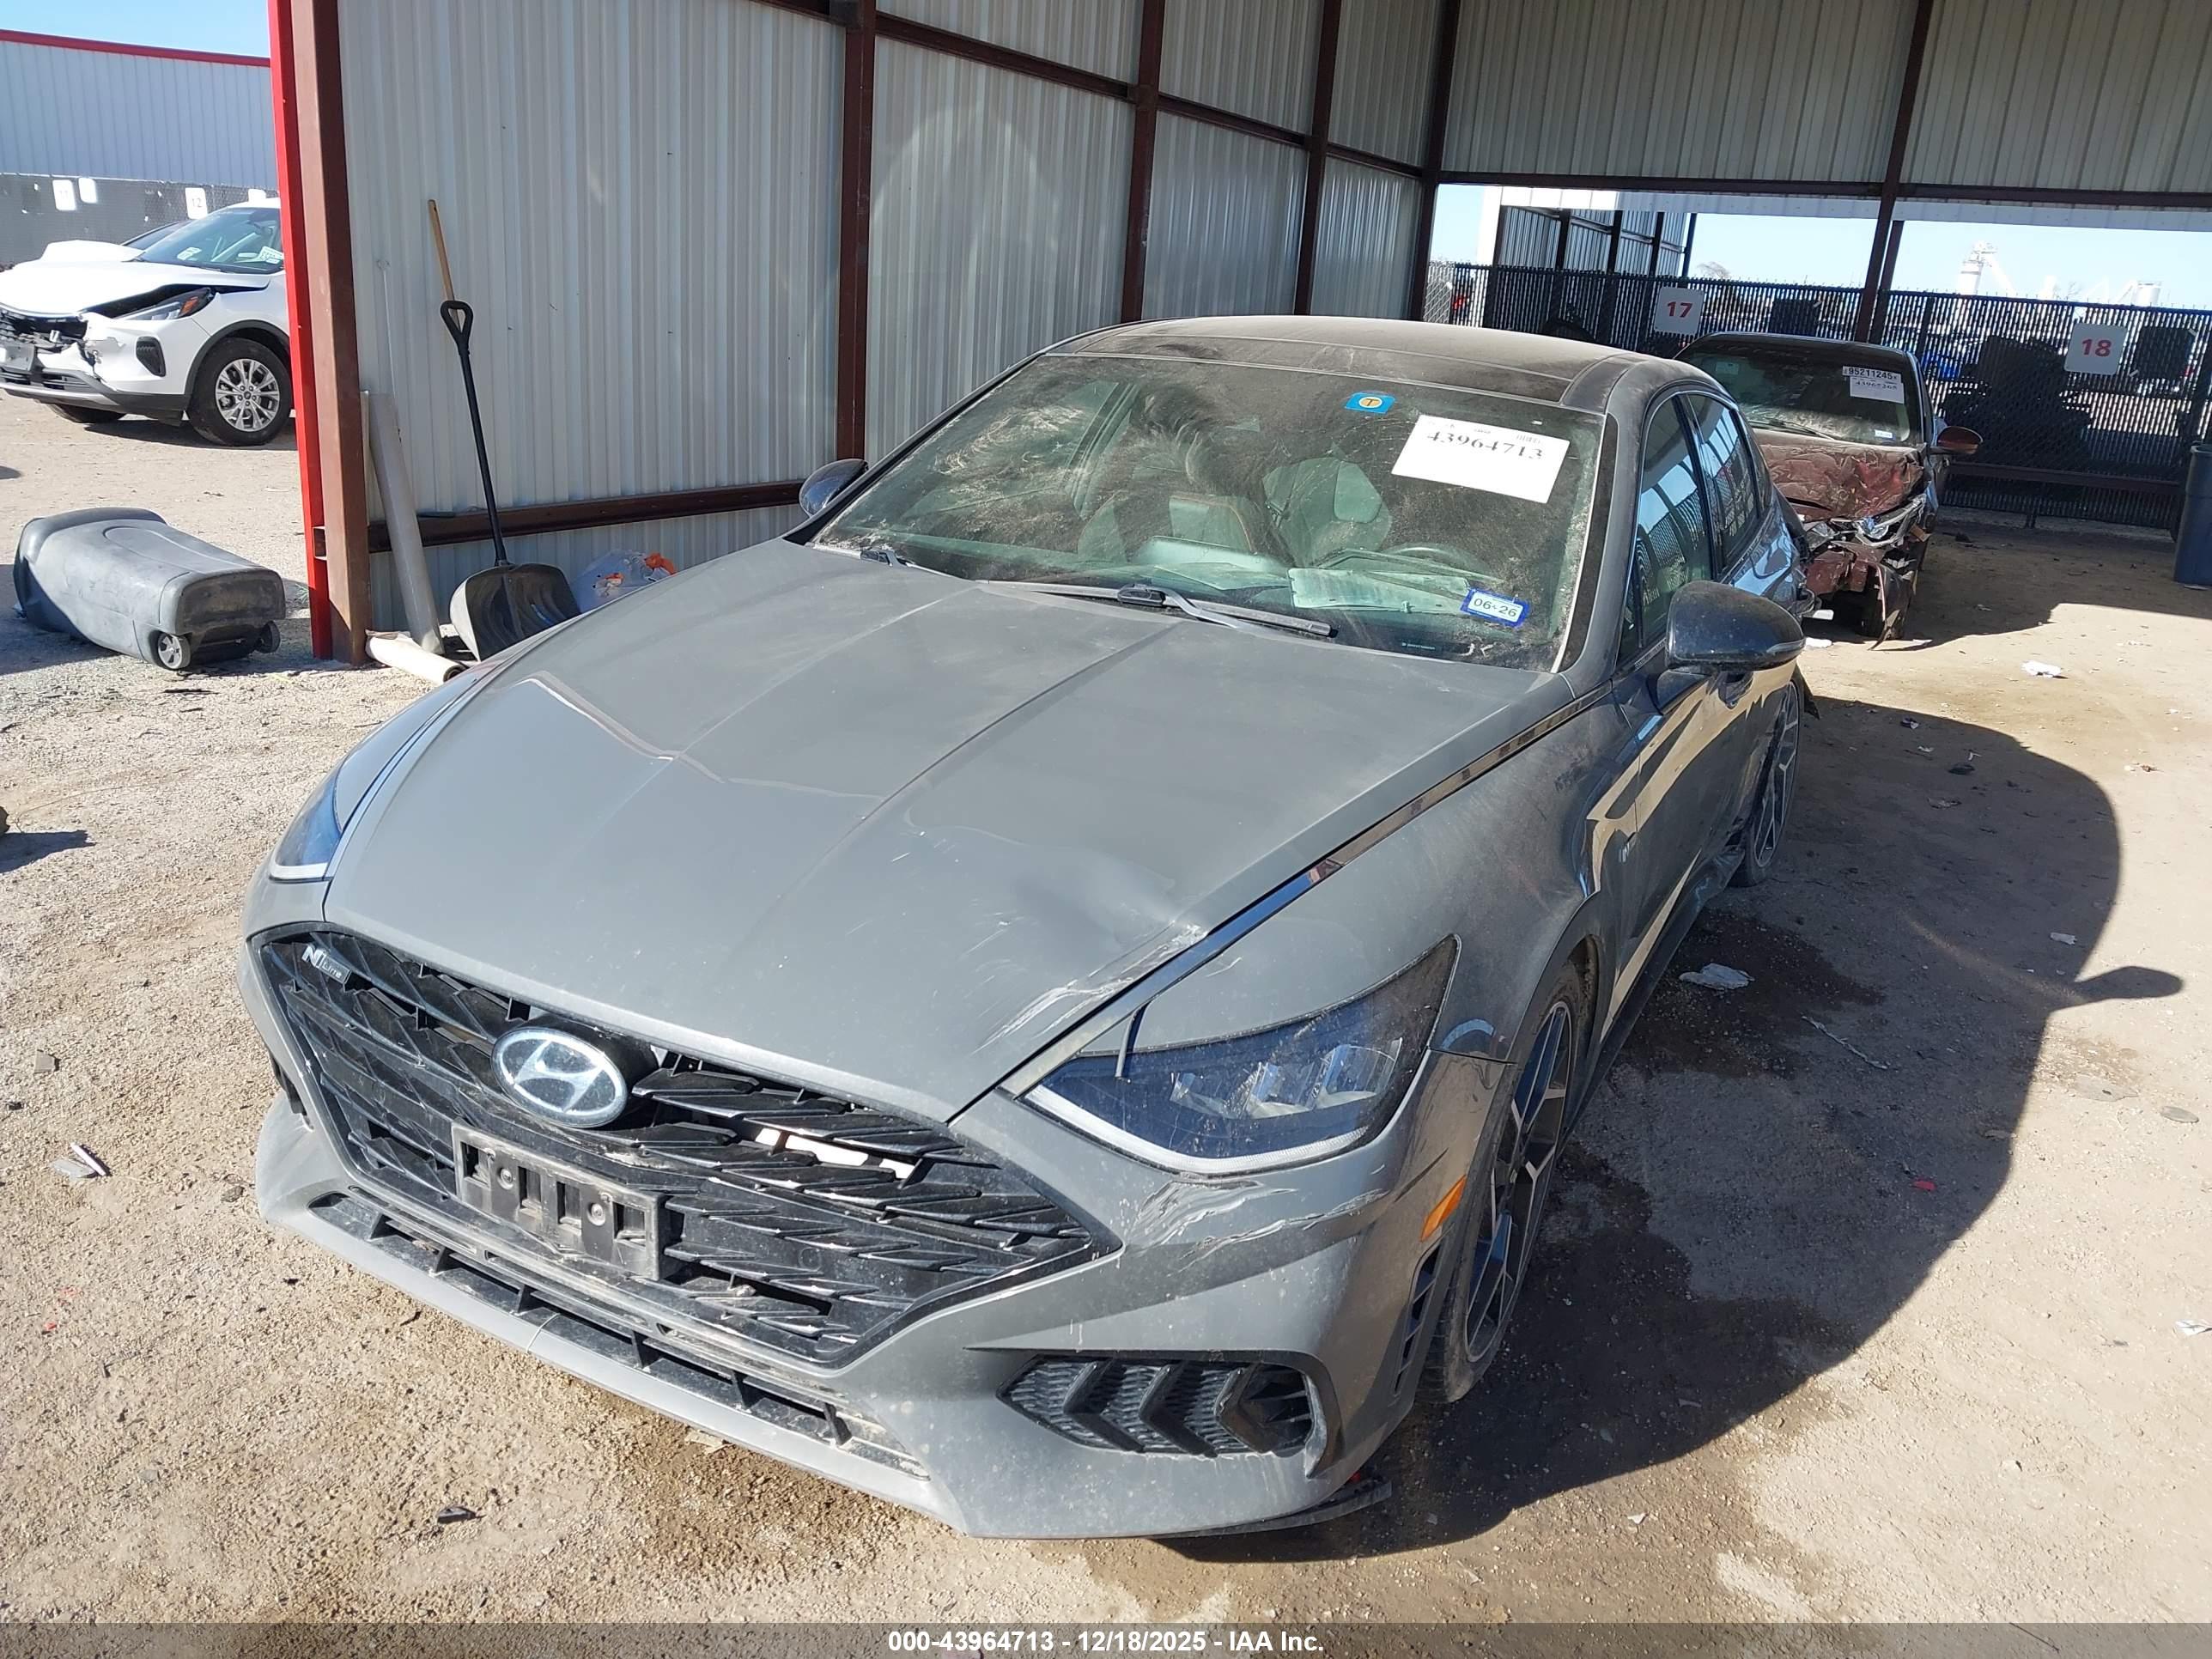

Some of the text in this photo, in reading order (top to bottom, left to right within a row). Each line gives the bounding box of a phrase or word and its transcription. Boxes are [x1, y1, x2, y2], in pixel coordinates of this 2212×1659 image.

[191, 198, 203, 208] 12
[1668, 301, 1693, 318] 17
[2082, 338, 2112, 357] 18
[1848, 367, 1893, 380] 95211245
[1364, 398, 1379, 407] T
[1426, 431, 1543, 459] 43964713
